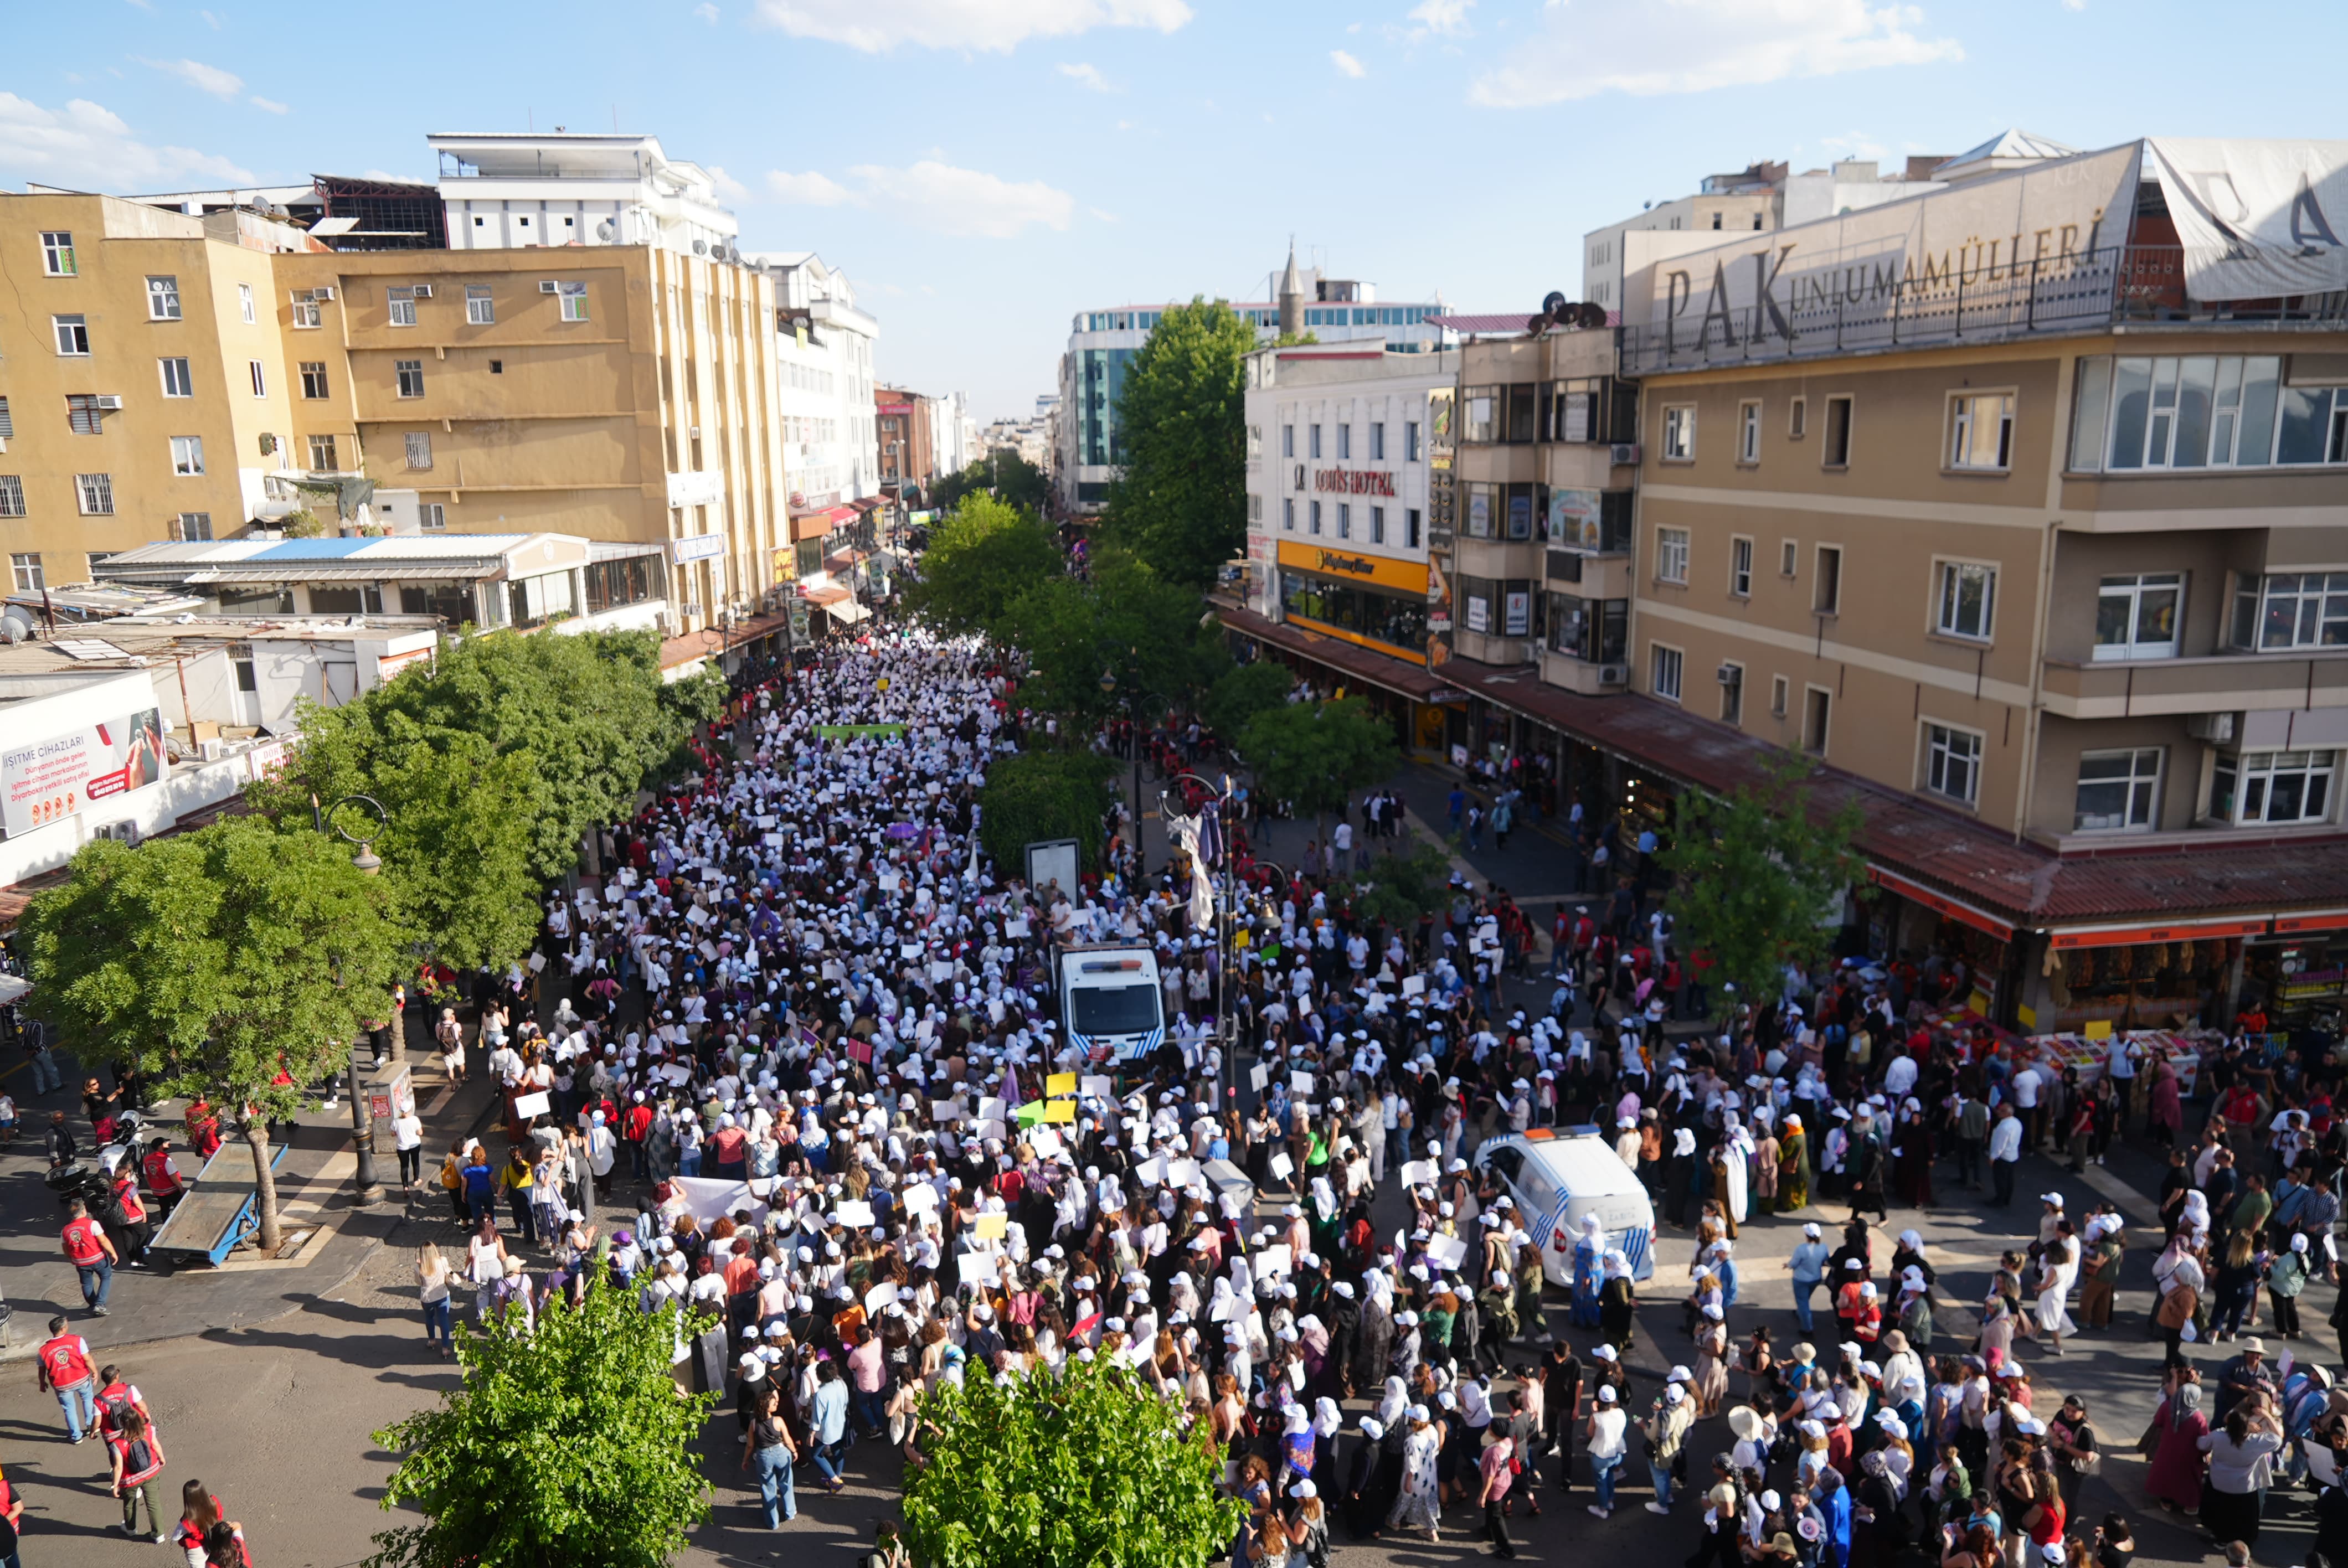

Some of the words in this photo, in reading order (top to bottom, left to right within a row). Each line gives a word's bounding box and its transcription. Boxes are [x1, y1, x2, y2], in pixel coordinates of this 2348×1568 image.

[1666, 243, 1800, 354] PAK
[1350, 470, 1395, 497] HOTEL
[38, 735, 85, 757] CİHAZLARI
[25, 760, 55, 775] Dünyanın
[55, 756, 70, 766] önde
[70, 751, 86, 763] gelen
[32, 772, 50, 784] cihazı
[50, 761, 88, 777] markalarının
[11, 786, 44, 802] Diyarbakır
